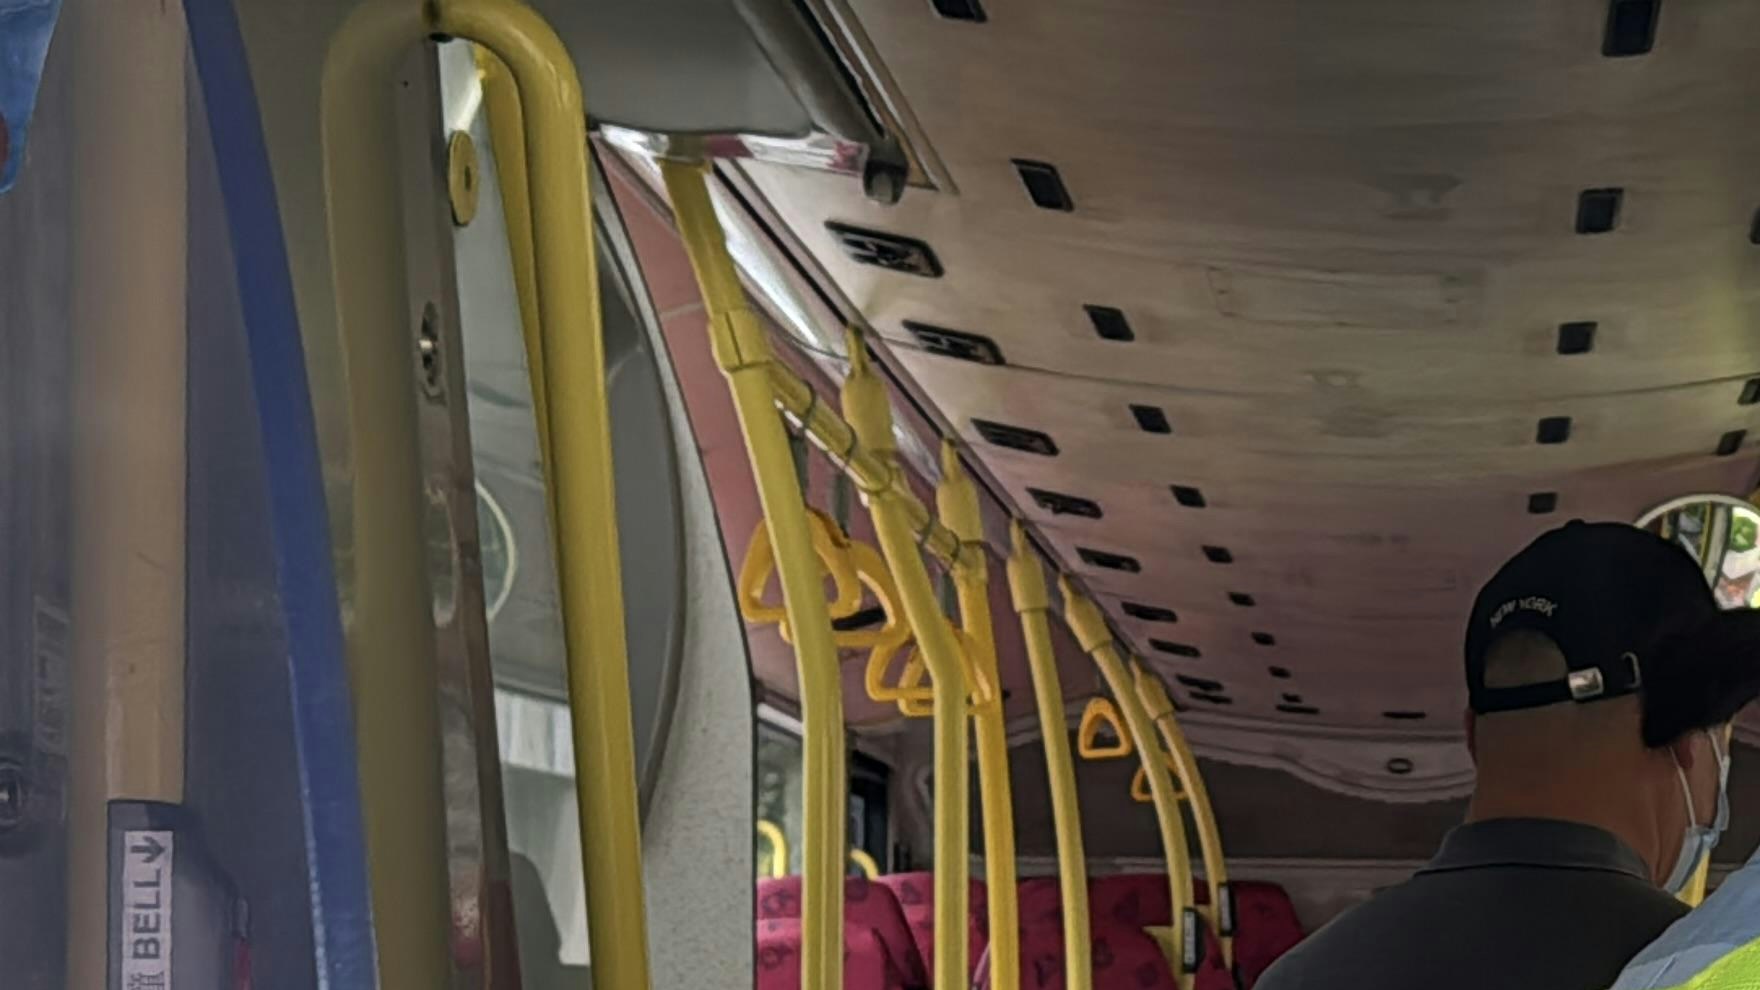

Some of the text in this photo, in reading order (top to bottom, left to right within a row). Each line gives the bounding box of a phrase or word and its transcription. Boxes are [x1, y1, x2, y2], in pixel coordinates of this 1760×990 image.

[1489, 596, 1558, 629] NEW YORK
[132, 868, 162, 960] BELL
